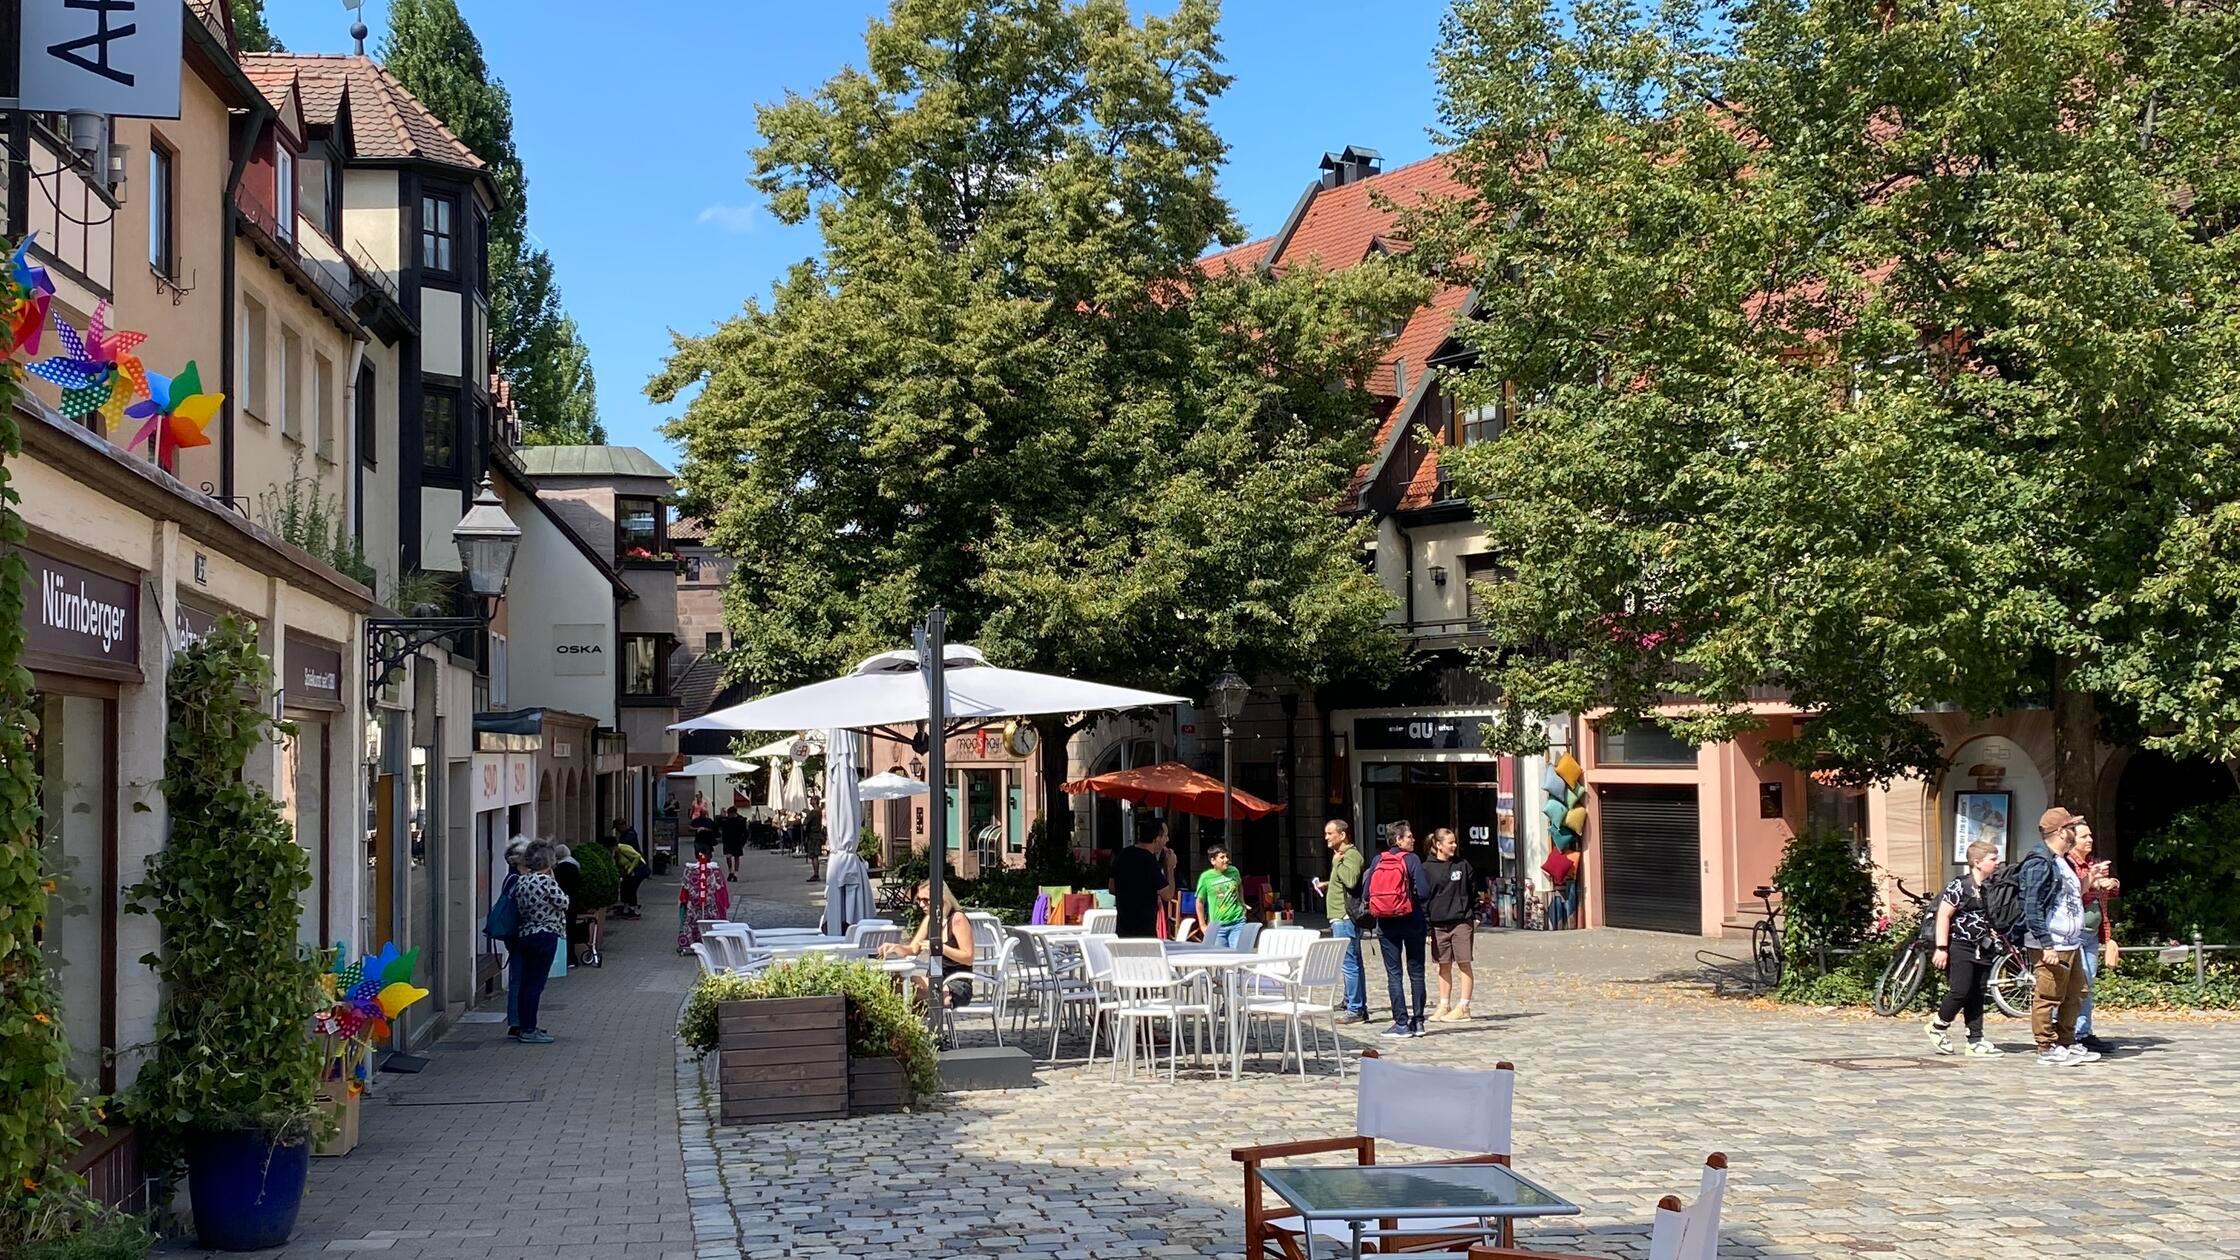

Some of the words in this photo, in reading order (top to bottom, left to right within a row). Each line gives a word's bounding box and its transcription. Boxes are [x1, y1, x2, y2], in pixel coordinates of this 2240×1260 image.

[47, 0, 137, 87] A
[42, 569, 125, 653] Nürnberger
[556, 645, 602, 653] OSKA
[1408, 722, 1434, 739] au
[1469, 826, 1490, 840] au
